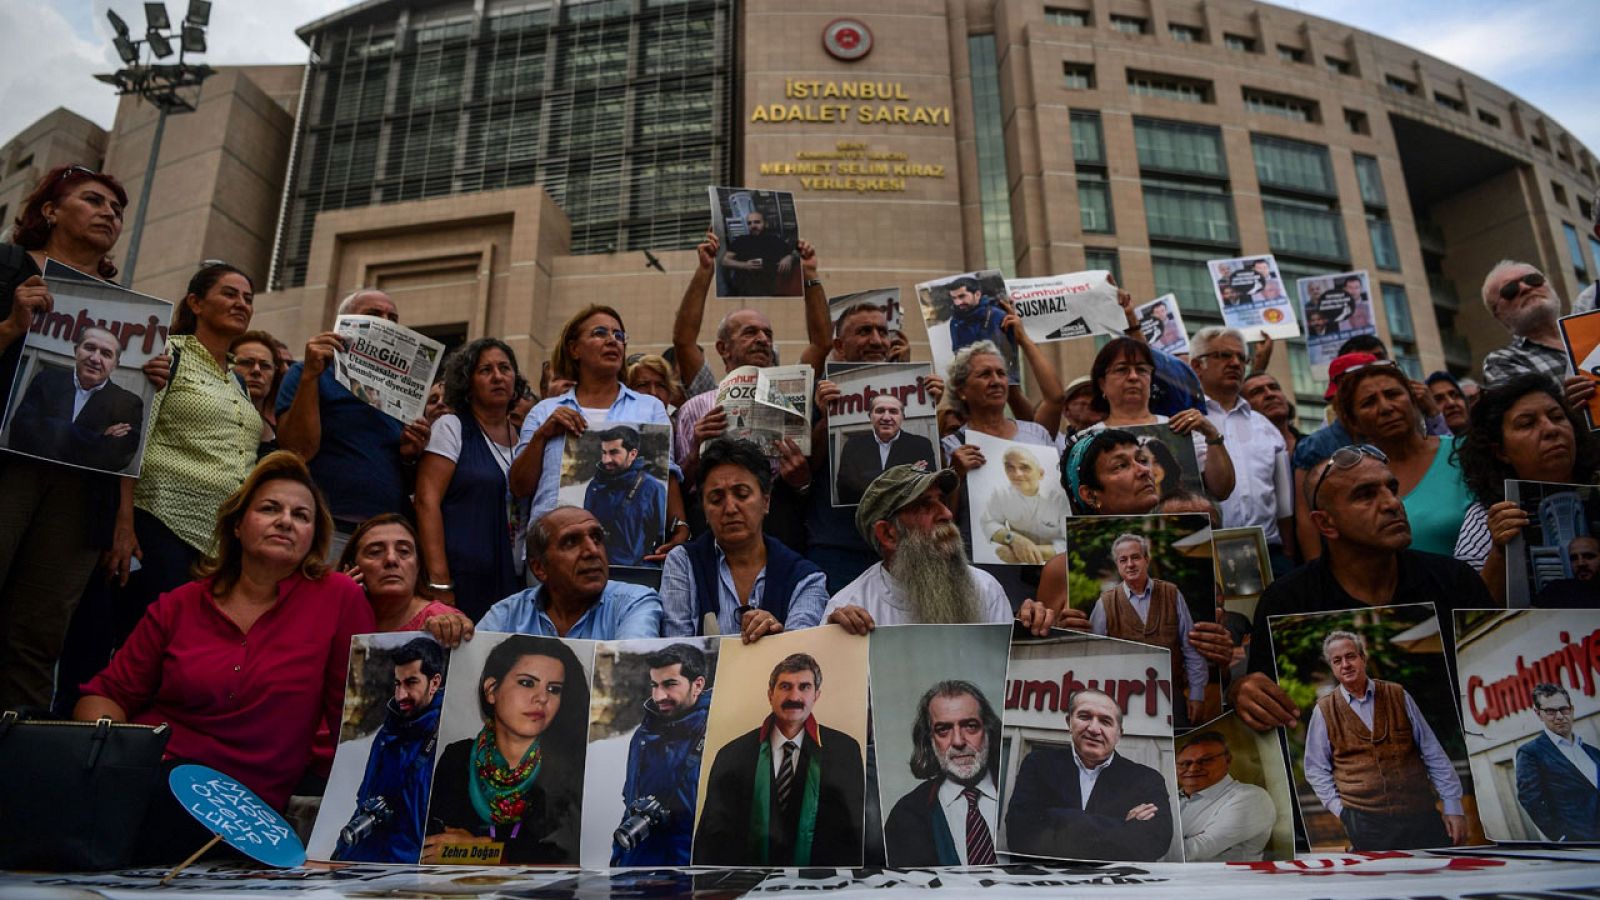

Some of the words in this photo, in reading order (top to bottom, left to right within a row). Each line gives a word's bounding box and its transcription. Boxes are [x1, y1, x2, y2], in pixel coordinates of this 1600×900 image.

[751, 104, 850, 123] ADALET
[858, 105, 950, 126] SARAYI
[760, 162, 832, 176] MEHMET
[1010, 283, 1092, 301] Cumhuriyet
[1015, 296, 1067, 318] SUSMAZ!
[441, 846, 468, 858] Zehra
[471, 846, 500, 861] Doğan
